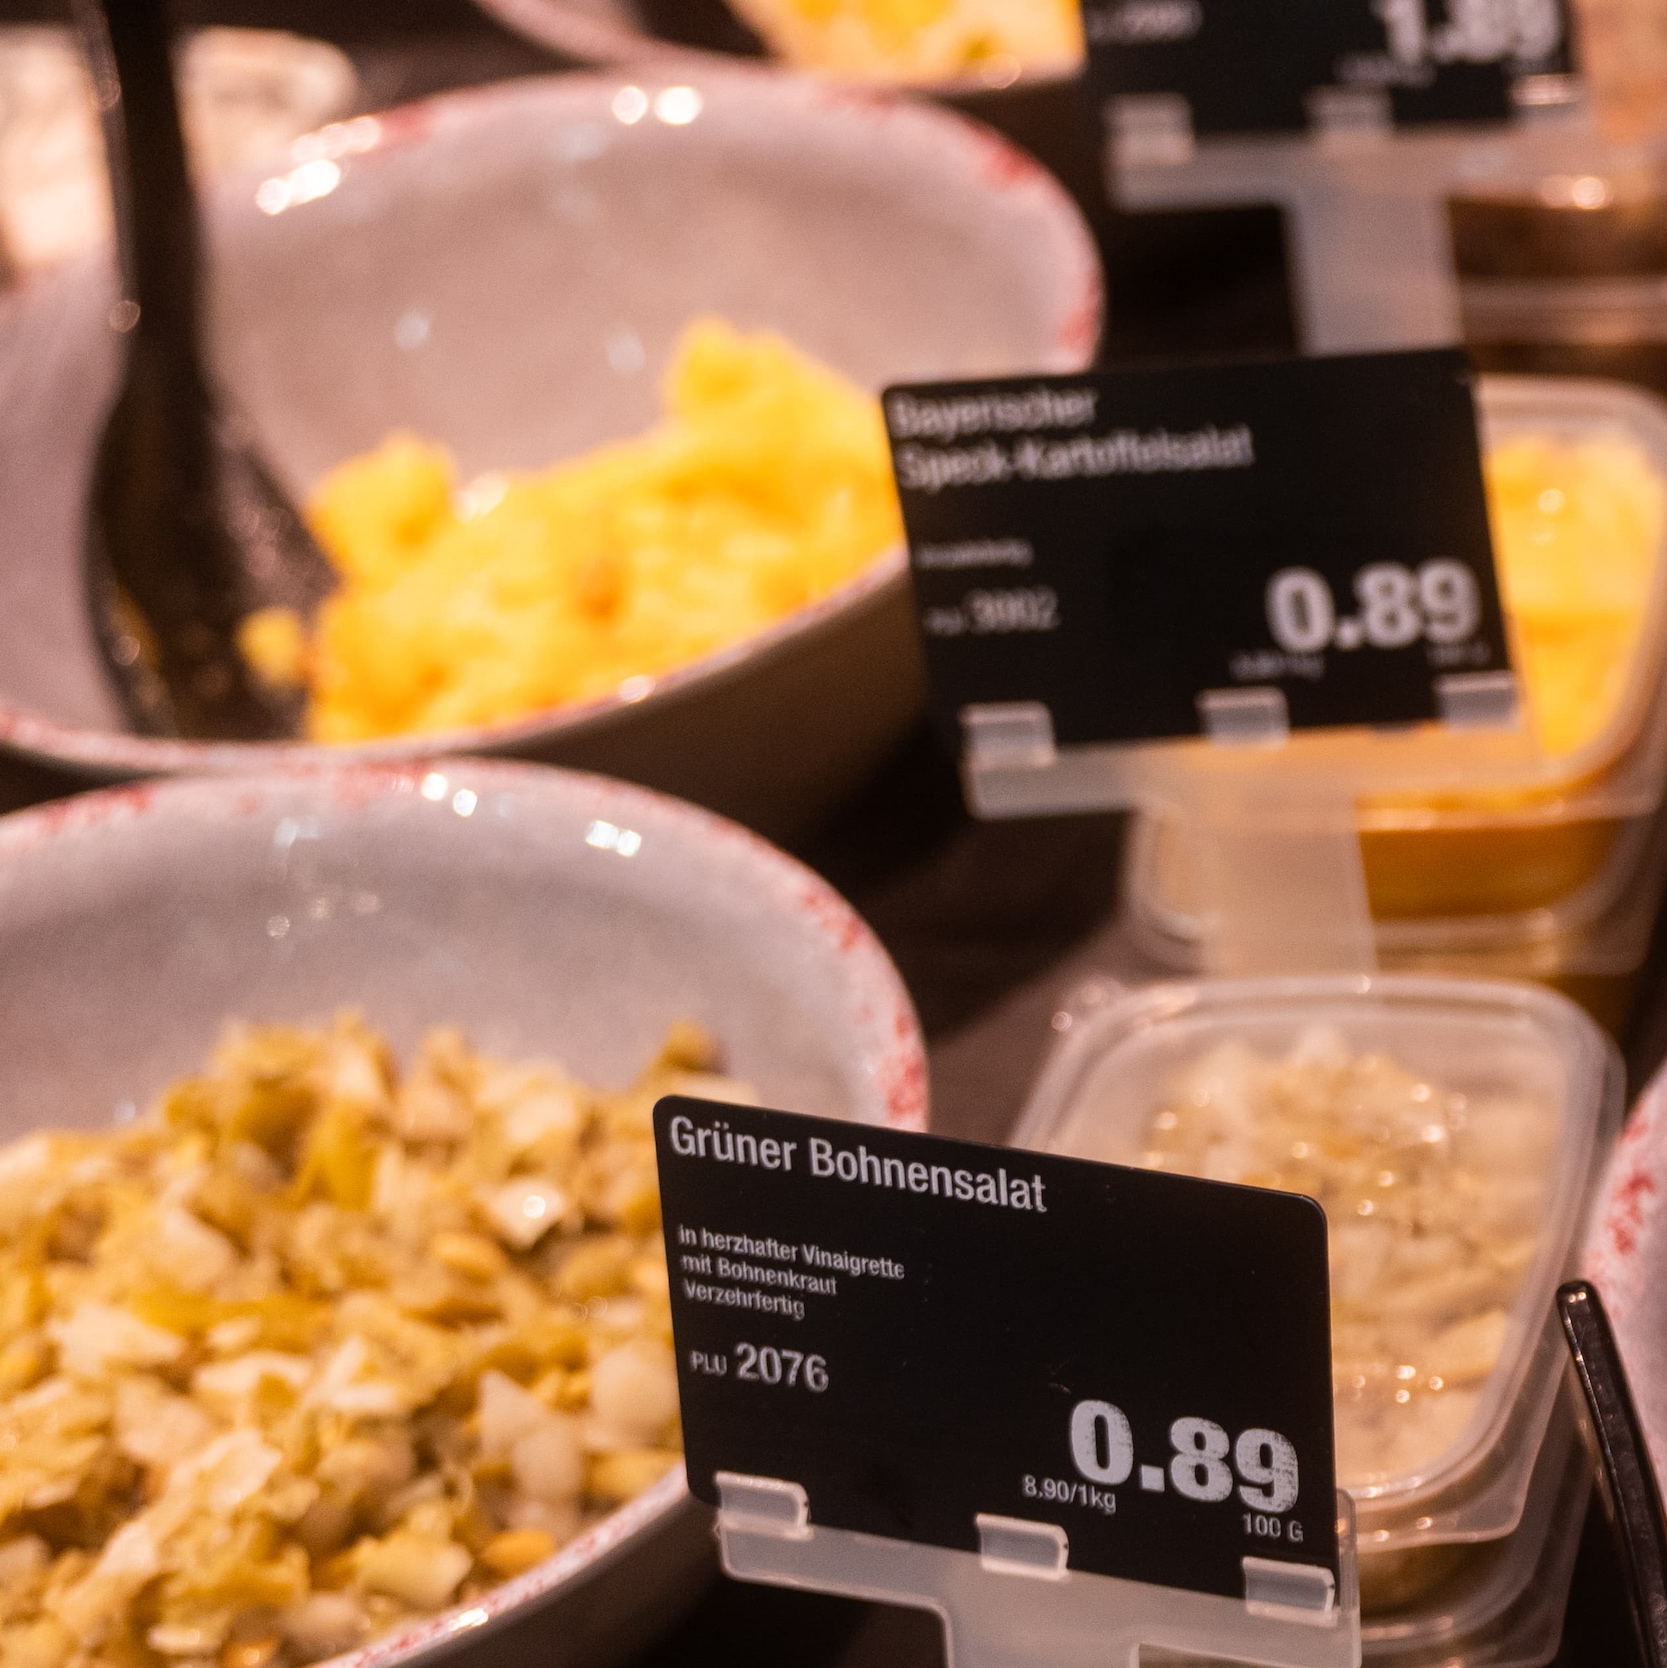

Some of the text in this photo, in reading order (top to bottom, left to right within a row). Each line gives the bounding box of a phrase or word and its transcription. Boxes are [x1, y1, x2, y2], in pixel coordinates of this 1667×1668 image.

[895, 387, 1097, 439] Bayerischer
[900, 425, 1254, 490] Speck-Kartoffelsalat
[1265, 559, 1481, 653] 0.89
[670, 1116, 1048, 1213] Grüner Bohnensalat
[679, 1225, 905, 1280] in herzhafter Vinaigrette
[682, 1252, 838, 1296] mit Bohnenkraut
[684, 1278, 806, 1320] Verzehrfertig
[690, 1343, 829, 1392] PLU 2076
[1068, 1399, 1299, 1514] 0.89
[1022, 1474, 1117, 1516] 8.90/1kg
[1242, 1513, 1303, 1543] 100 G
